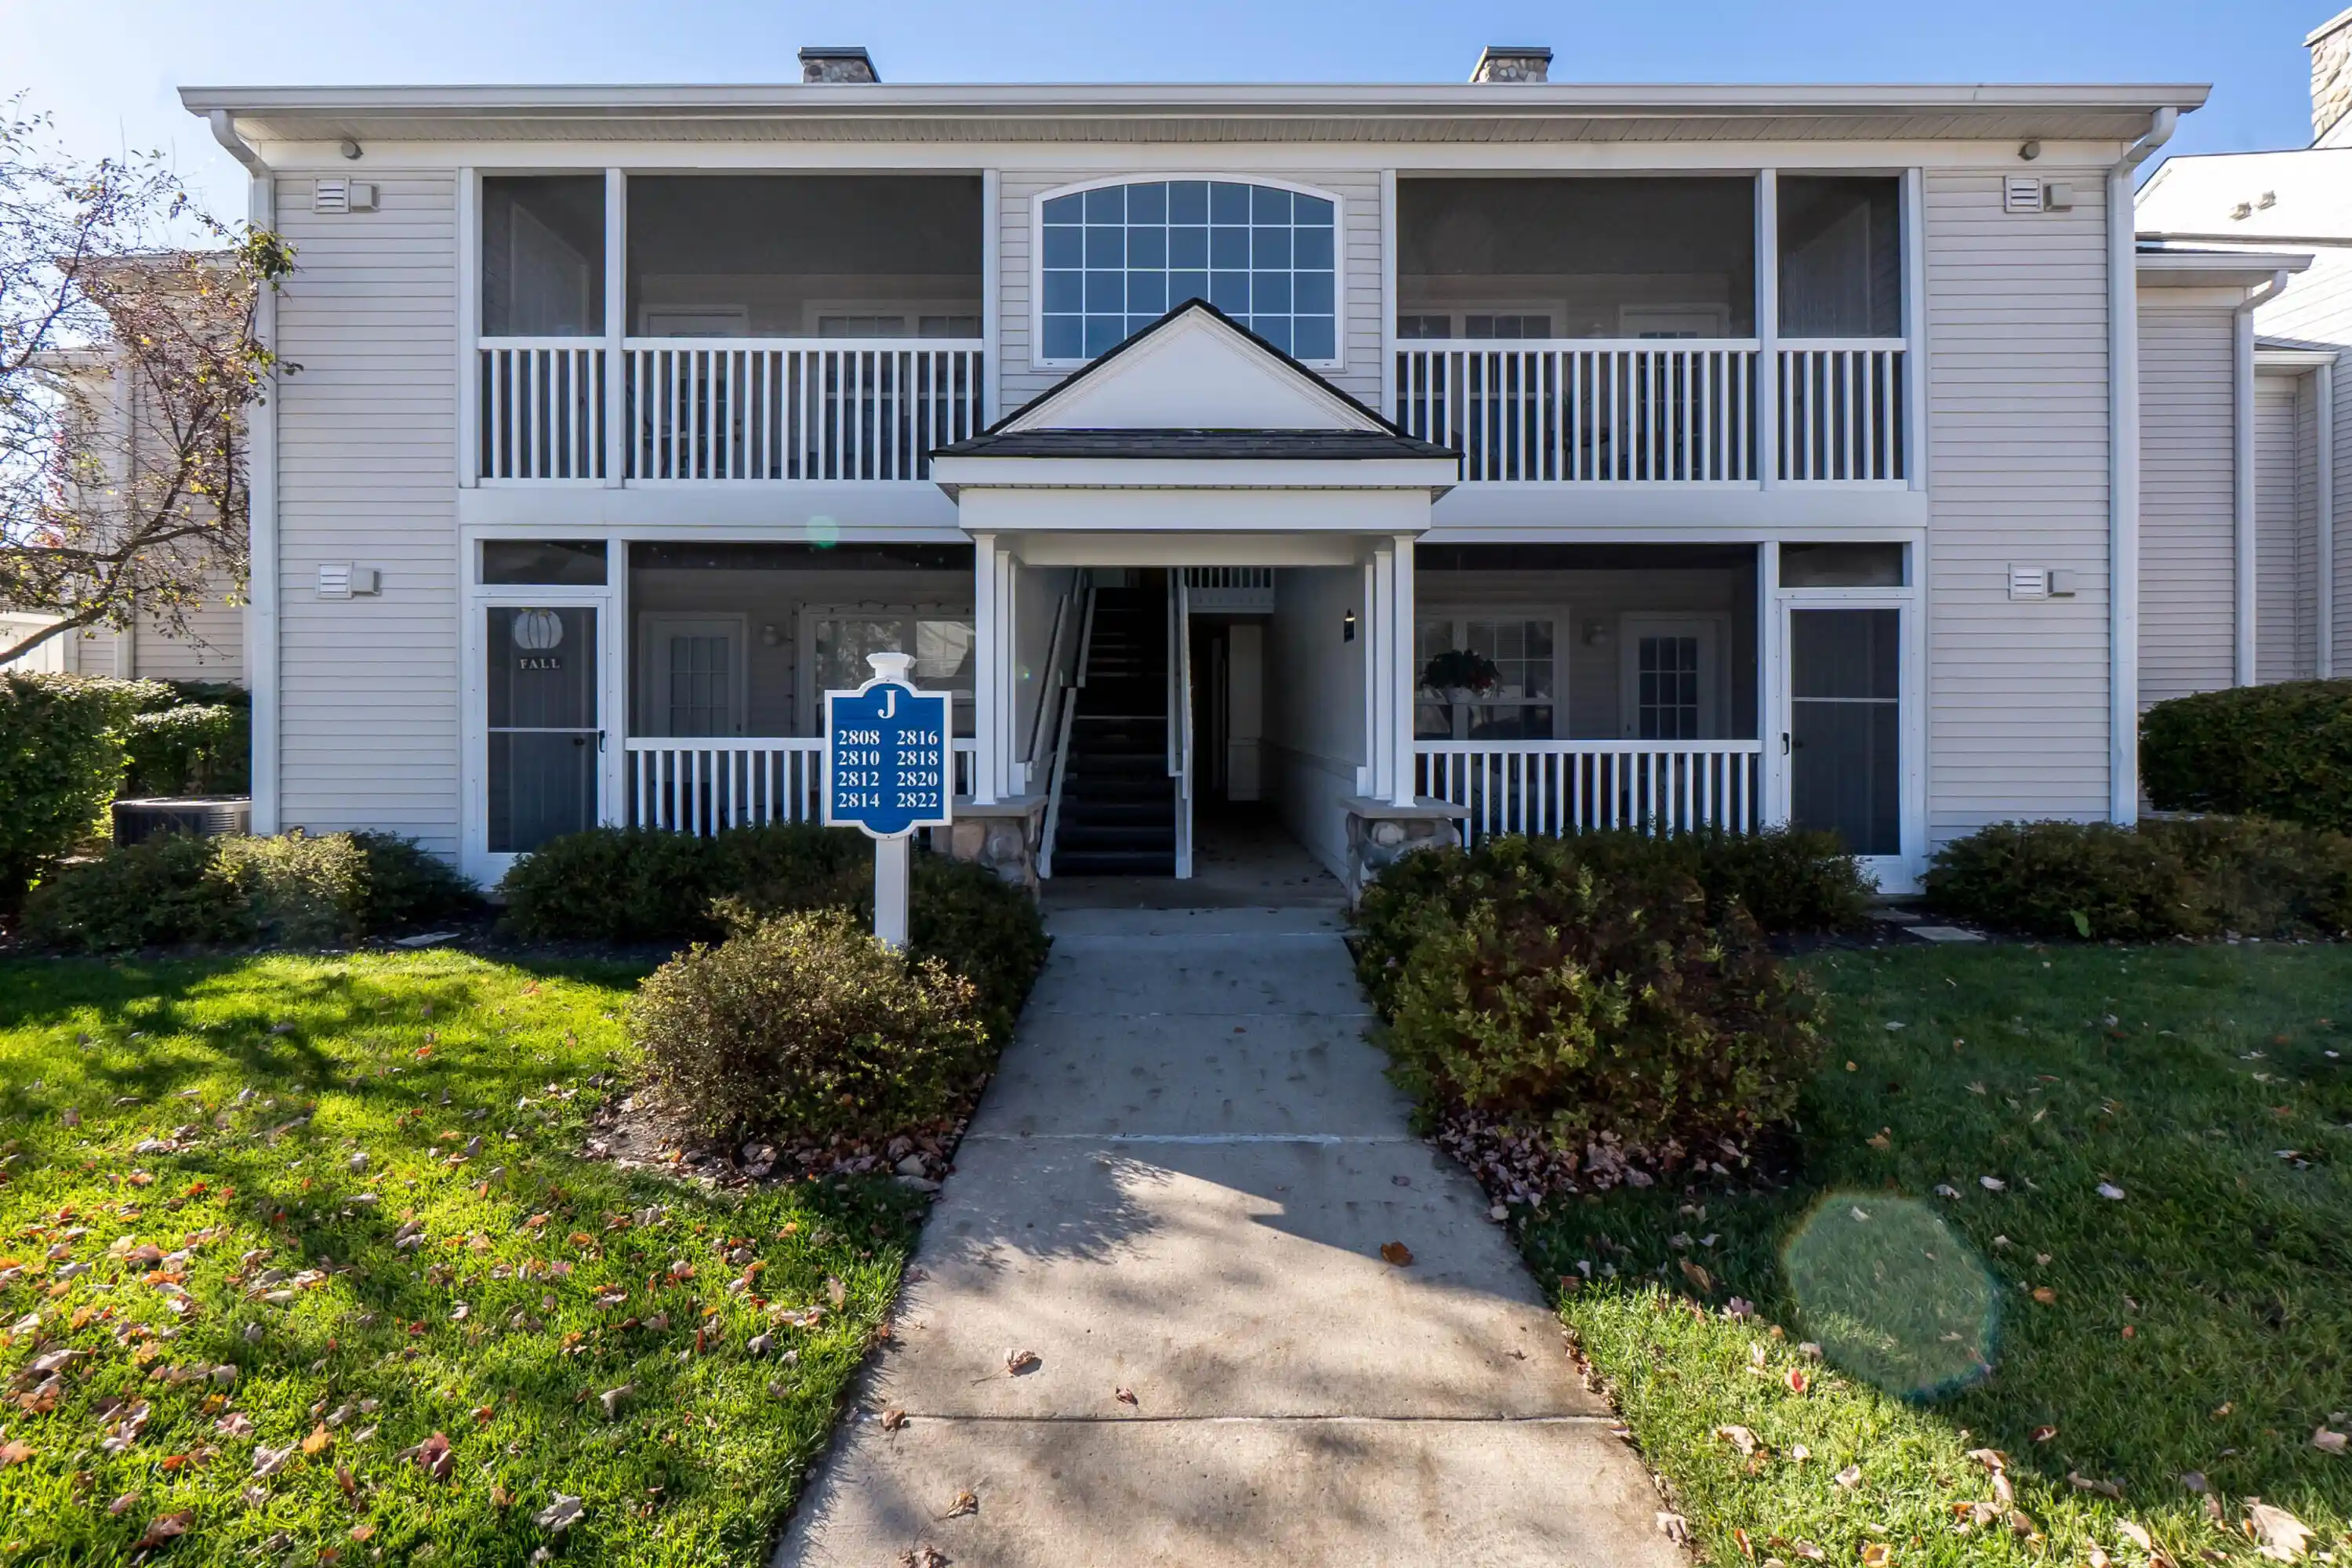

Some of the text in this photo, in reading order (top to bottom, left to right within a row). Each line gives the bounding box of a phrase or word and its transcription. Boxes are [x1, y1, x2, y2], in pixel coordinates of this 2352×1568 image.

[520, 659, 561, 670] FALL
[877, 689, 898, 719] J
[838, 730, 880, 745] 2808
[896, 730, 938, 746] 2816
[838, 750, 880, 766] 2810
[896, 750, 938, 766] 2818
[838, 771, 879, 786] 2812
[896, 771, 938, 786] 2820
[838, 792, 880, 808] 2814
[896, 792, 938, 808] 2822
